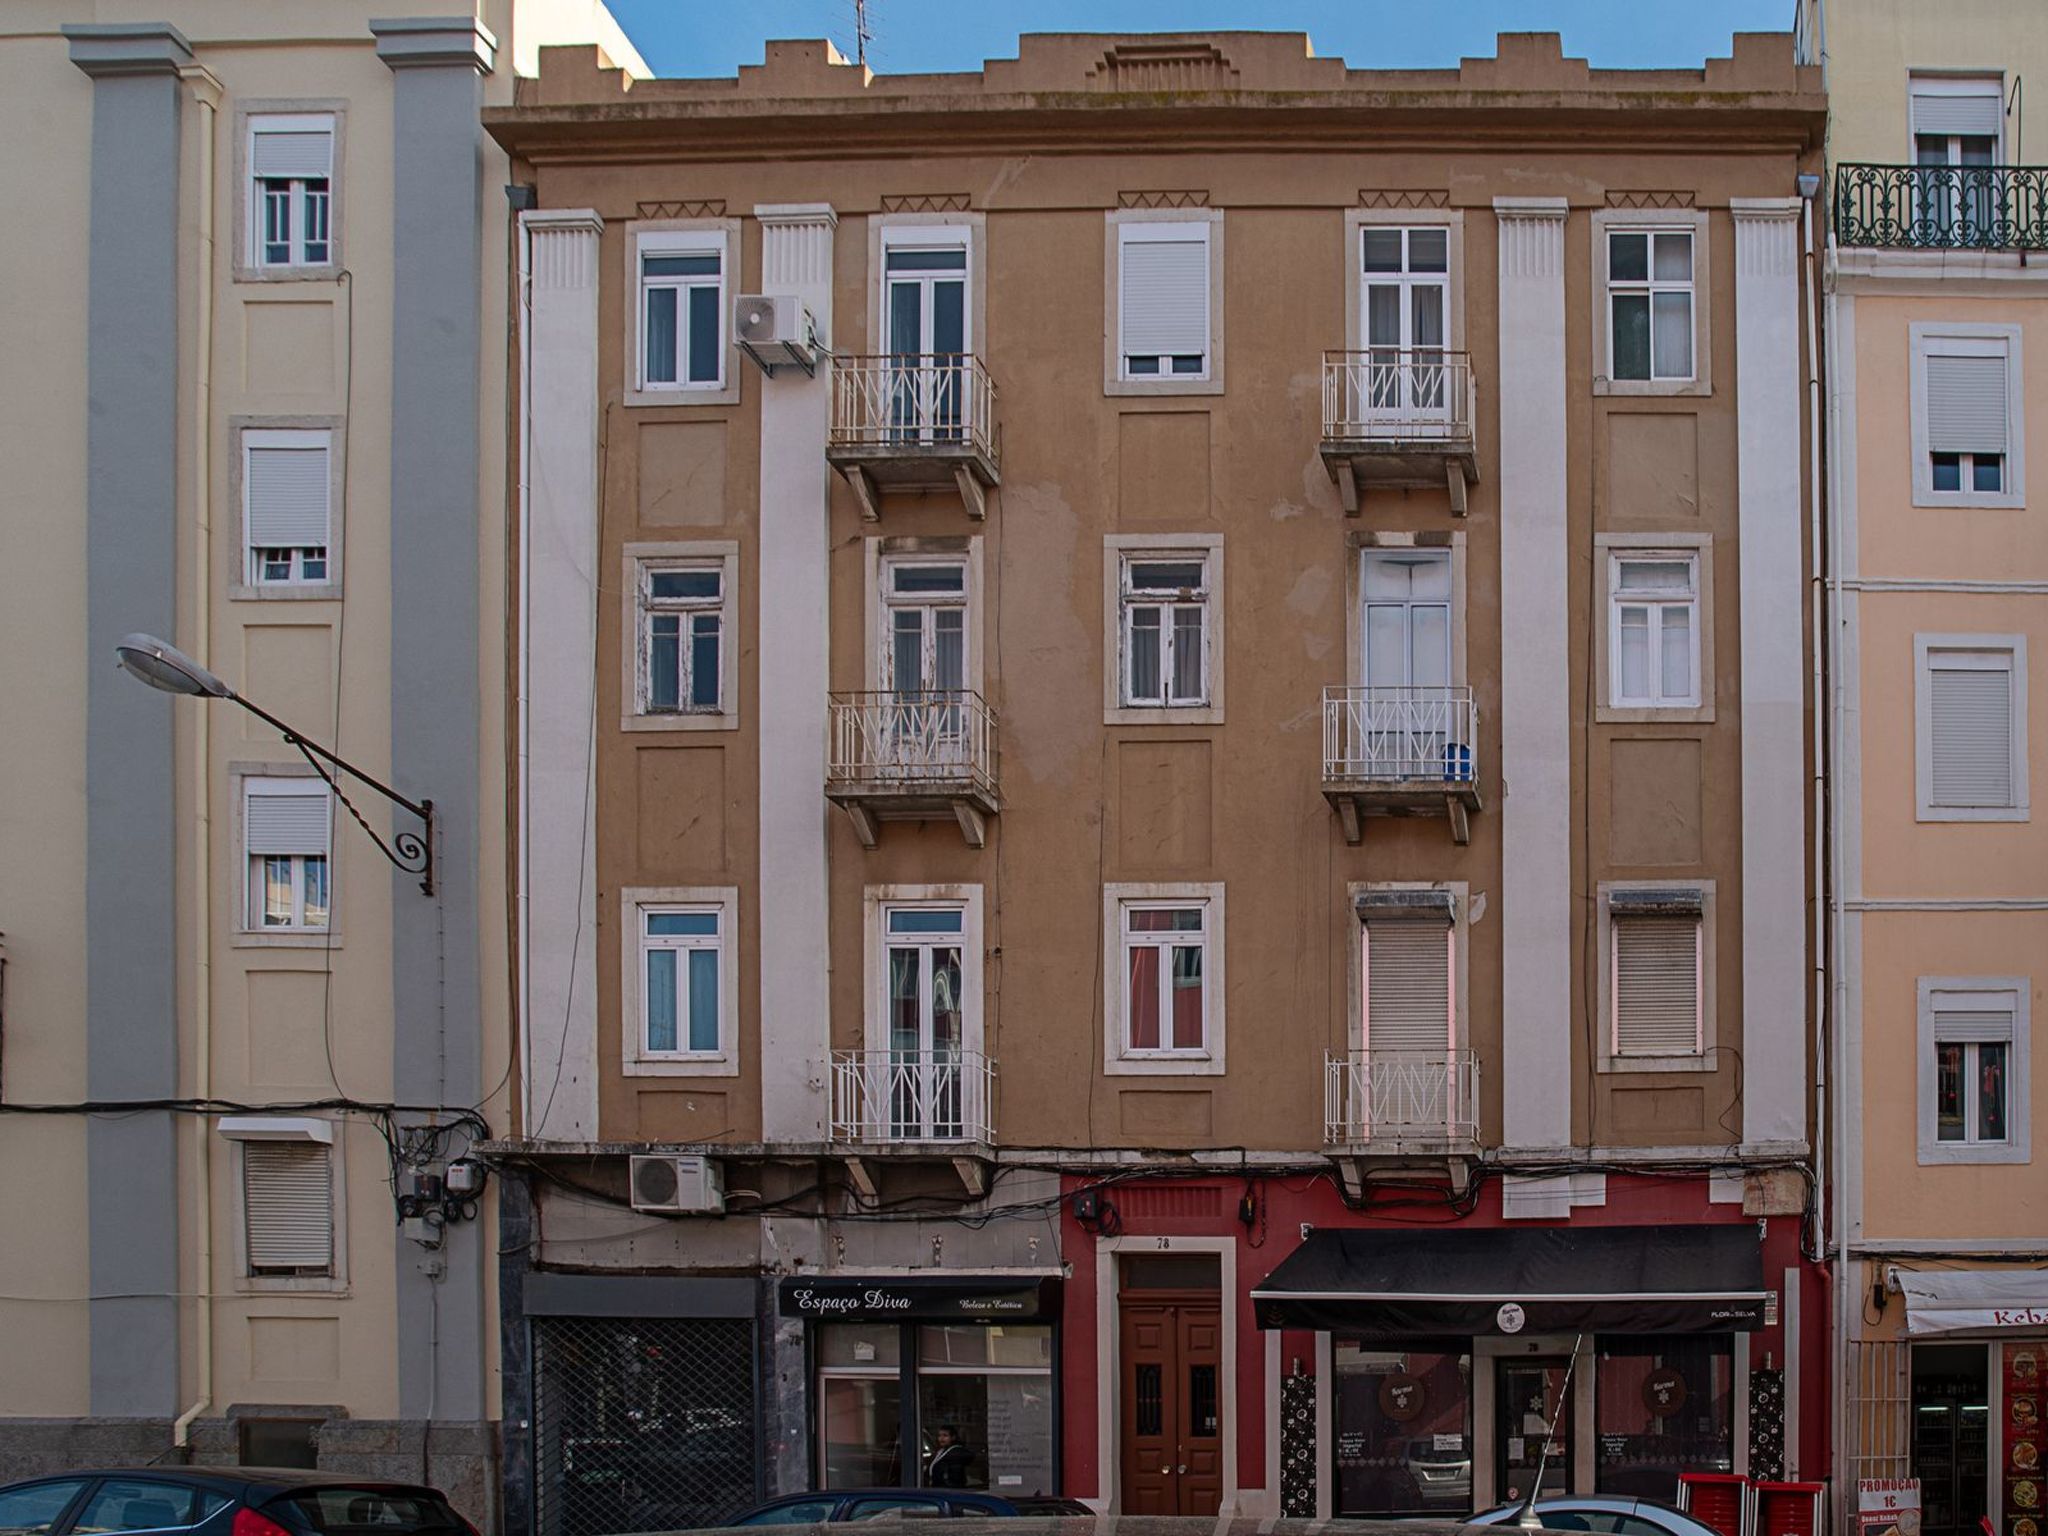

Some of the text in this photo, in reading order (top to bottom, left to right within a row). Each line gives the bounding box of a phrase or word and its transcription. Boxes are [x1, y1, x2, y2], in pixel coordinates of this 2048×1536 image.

[1157, 1237, 1170, 1249] 78
[793, 1289, 912, 1315] Espaço Diva
